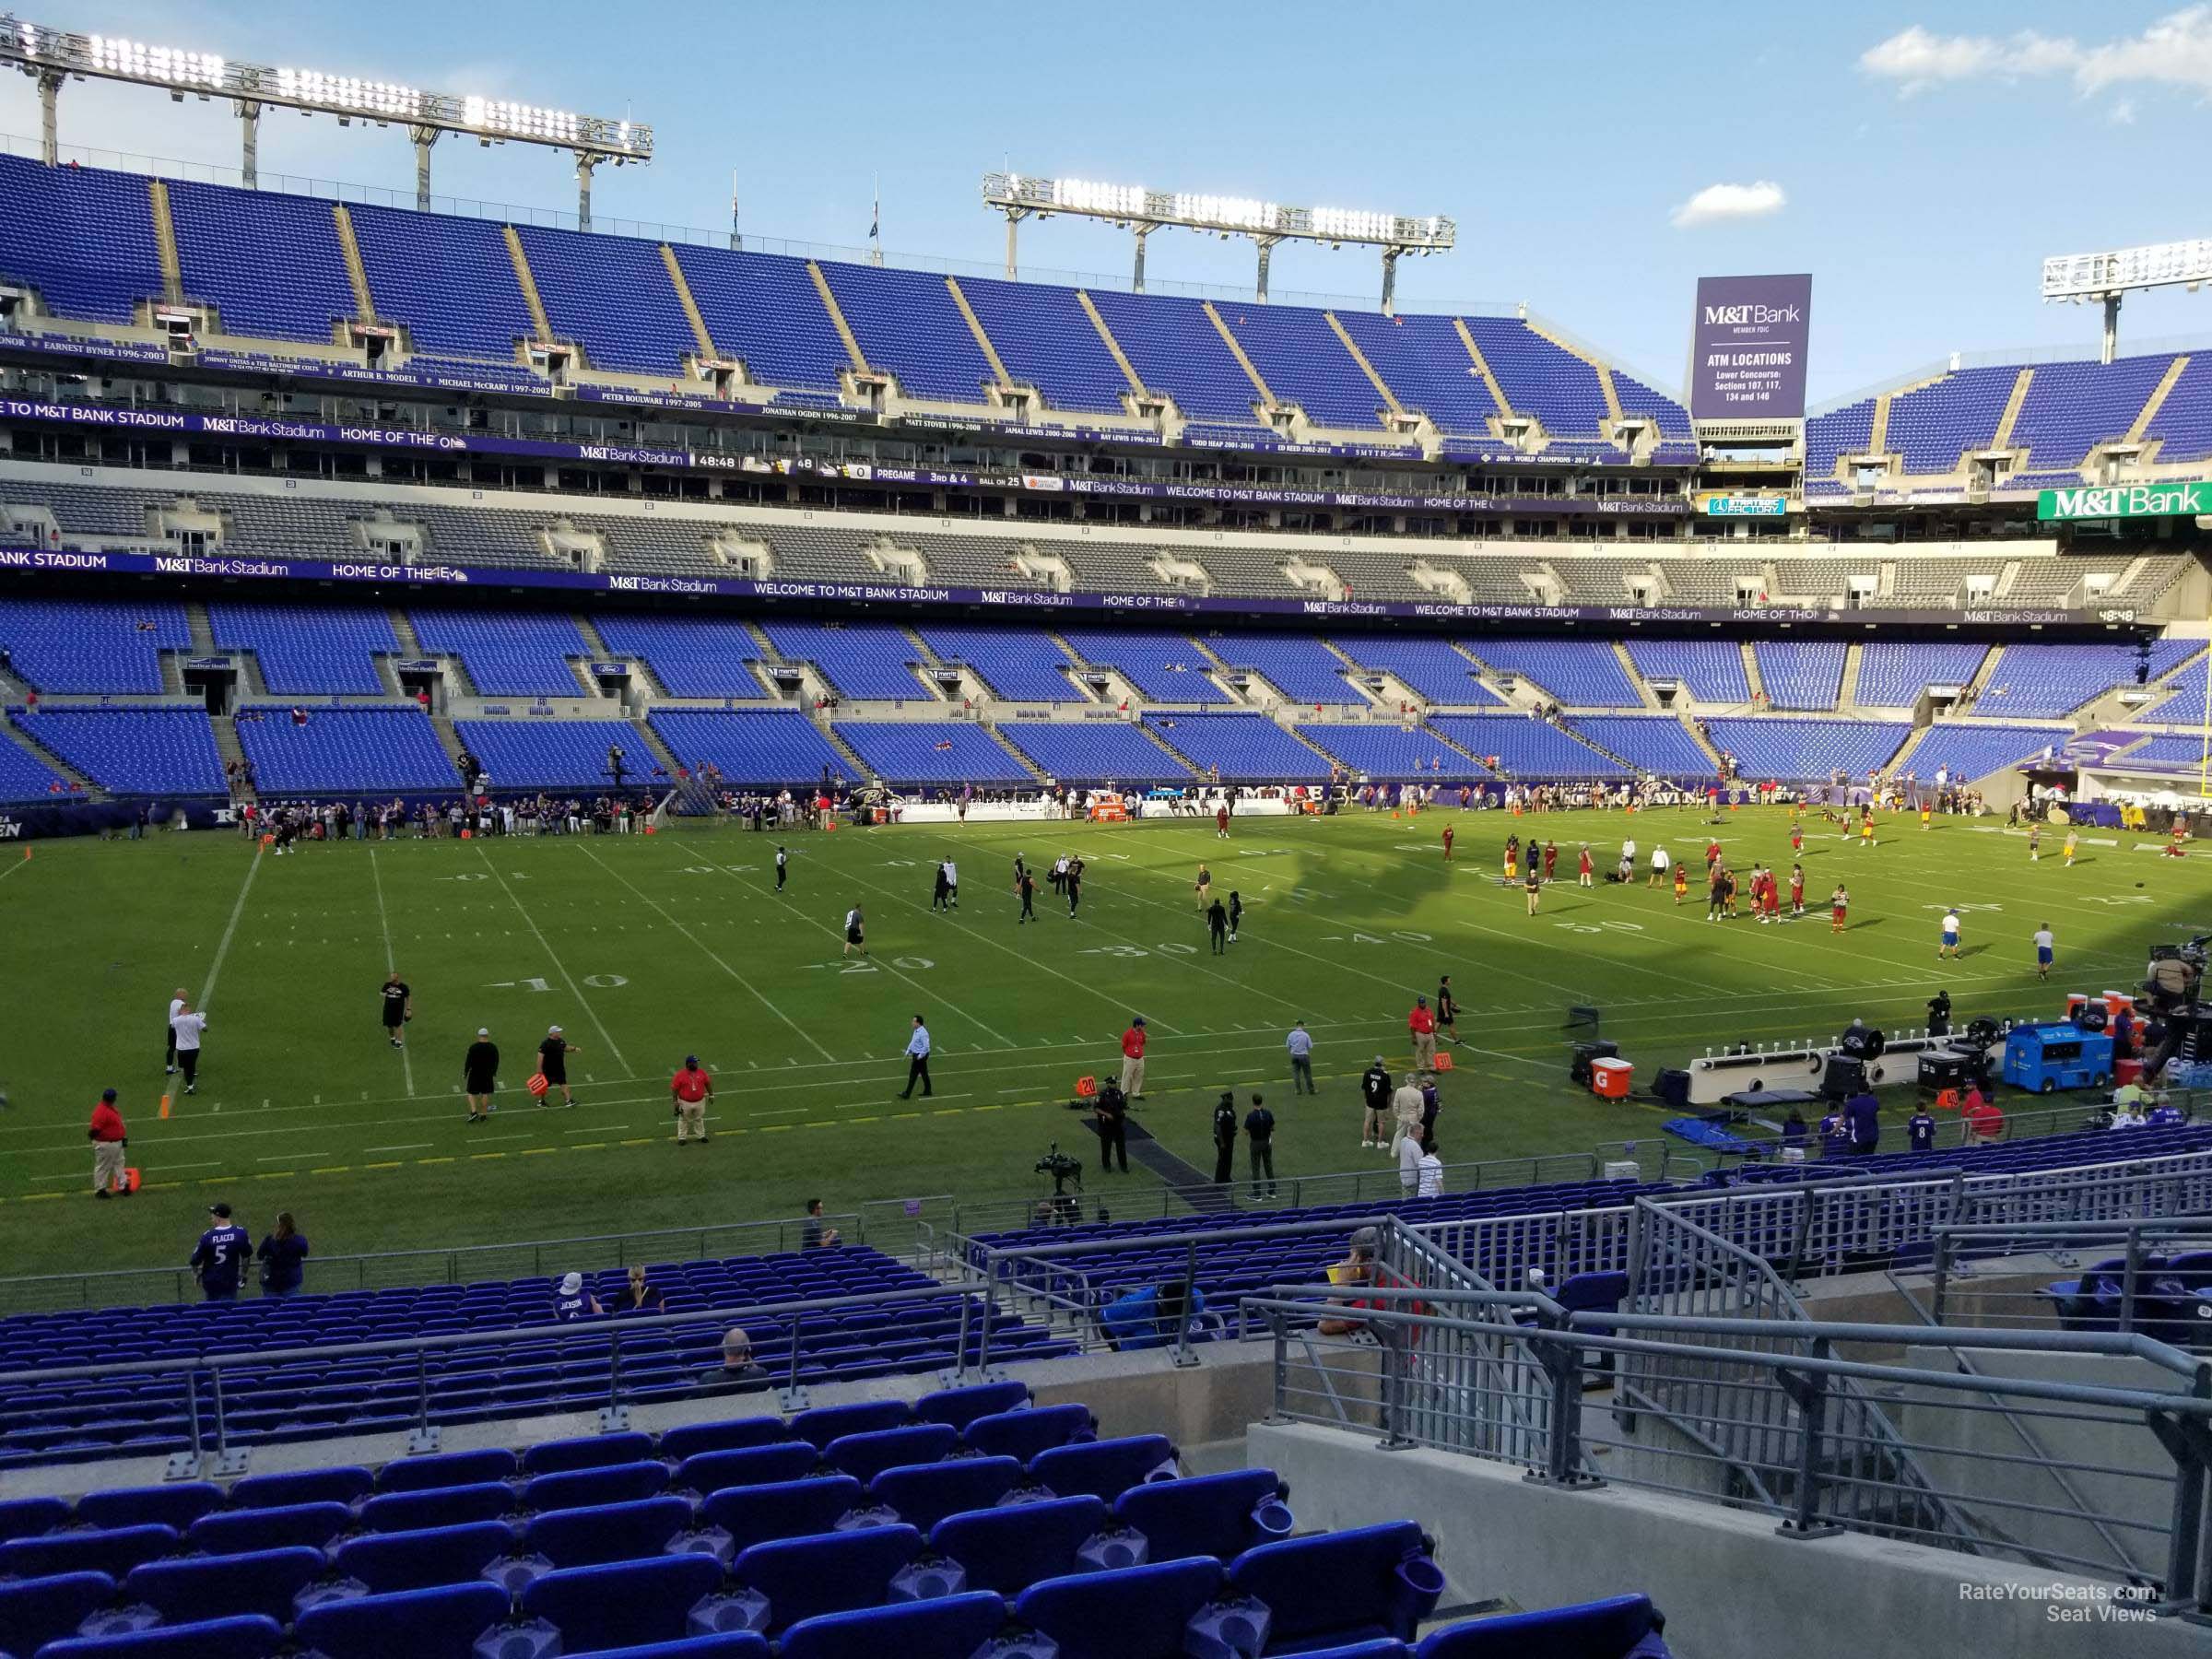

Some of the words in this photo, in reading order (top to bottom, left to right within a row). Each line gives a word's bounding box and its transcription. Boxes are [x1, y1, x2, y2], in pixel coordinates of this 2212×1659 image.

[1705, 306, 1753, 324] M&T
[1755, 304, 1799, 323] Bank
[0, 336, 26, 347] ONOR
[44, 342, 83, 354] EARNEST
[87, 346, 115, 357] BYNER
[118, 348, 165, 360] 1996-2003
[205, 357, 229, 365] JOHNNY
[229, 359, 250, 367] UNITAS
[268, 361, 300, 371] BALTIMORE
[1708, 354, 1729, 367] ATM
[1733, 353, 1791, 366] LOCATIONS
[343, 370, 374, 380] ARTHUR
[387, 372, 418, 383] MODELL
[439, 378, 472, 389] MICHAEL
[474, 382, 509, 391] McCRARY
[511, 384, 551, 395] 1997-2002
[1715, 382, 1746, 391] Sections
[1748, 382, 1763, 390] 107,
[626, 395, 663, 404] BOULWARE
[665, 398, 701, 407] 1997-2005
[1725, 393, 1739, 401] 134
[7, 402, 30, 415] TO
[35, 406, 68, 418] M&T
[73, 407, 115, 423] BANK
[118, 411, 184, 428] STADIUM
[762, 407, 796, 416] JONATHAN
[823, 412, 856, 420] 1996-2007
[203, 417, 238, 432] M&T
[239, 419, 271, 435] Bank
[271, 422, 325, 439] Stadium
[341, 428, 382, 442] HOME
[385, 431, 404, 442] OF
[407, 433, 435, 445] THE
[580, 446, 609, 459] M&T
[610, 449, 637, 461] Bank
[639, 451, 682, 465] Stadium
[700, 456, 735, 467] 48:48
[798, 459, 811, 467] 48
[857, 467, 865, 477] 0
[877, 469, 915, 480] PREGAME
[949, 474, 957, 482] &
[960, 475, 967, 483] 4
[1008, 477, 1019, 486] 25
[1069, 480, 1093, 490] M&T
[1094, 482, 1116, 492] Bank
[1117, 483, 1153, 494] Stadium
[1167, 487, 1215, 498] WELCOME
[1218, 489, 1230, 498] TO
[1233, 490, 1253, 499] M&T
[1256, 491, 1281, 500] BANK
[1284, 493, 1324, 502] STADIUM
[1335, 494, 1357, 505] M&T
[1359, 496, 1379, 505] Bank
[1380, 497, 1414, 507] Stadium
[2053, 488, 2127, 517] M&T
[2129, 484, 2201, 514] Bank
[1424, 499, 1451, 507] HOME
[1453, 499, 1466, 507] OF
[1469, 500, 1487, 508] THE
[1597, 501, 1620, 512] M&T
[1621, 503, 1643, 512] Bank
[1645, 503, 1682, 512] Stadium
[0, 551, 30, 564] ANK
[34, 553, 107, 568] STADIUM
[155, 557, 194, 571] M&T
[194, 559, 230, 573] Bank
[231, 560, 288, 575] Stadium
[333, 564, 376, 577] HOME
[380, 566, 400, 579] OF
[404, 568, 432, 579] THE
[610, 576, 640, 589] M&T
[641, 577, 669, 591] Bank
[671, 579, 716, 593] Stadium
[754, 583, 815, 595] WELCOME
[818, 585, 835, 596] TO
[838, 587, 862, 597] M&T
[865, 588, 896, 598] BANK
[900, 589, 948, 600] STADIUM
[982, 592, 1007, 603] M&T
[1008, 593, 1031, 603] Bank
[1032, 594, 1073, 605] Stadium
[1103, 595, 1134, 606] HOME
[1136, 597, 1151, 606] OF
[1155, 597, 1173, 606] THE
[1303, 602, 1327, 612] M&T
[1328, 603, 1349, 613] Bank
[1351, 603, 1386, 614] Stadium
[1416, 606, 1464, 615] WELCOME
[1466, 606, 1480, 616] TO
[1482, 606, 1502, 616] M&T
[1505, 607, 1533, 617] BANK
[1535, 608, 1578, 618] STADIUM
[1610, 608, 1635, 619] M&T
[1636, 609, 1659, 619] Bank
[1662, 609, 1700, 619] Stadium
[1734, 610, 1767, 618] HOME
[1770, 610, 1785, 618] OF
[1964, 612, 1993, 622] M&T
[1994, 612, 2021, 621] Bank
[2023, 611, 2067, 621] Stadium
[2100, 610, 2133, 621] 48:48
[1101, 943, 1198, 957] 30
[828, 957, 935, 974] 20
[519, 974, 629, 992] 10
[1439, 1054, 1450, 1067] 30
[1082, 1078, 1095, 1093] 20
[1596, 1071, 1607, 1088] G
[1371, 1080, 1378, 1093] 9
[1947, 1091, 1958, 1106] 40
[1919, 1126, 1925, 1139] 8
[212, 1233, 234, 1243] FLACCO
[214, 1245, 227, 1265] 5
[560, 1298, 582, 1310] JACKSON
